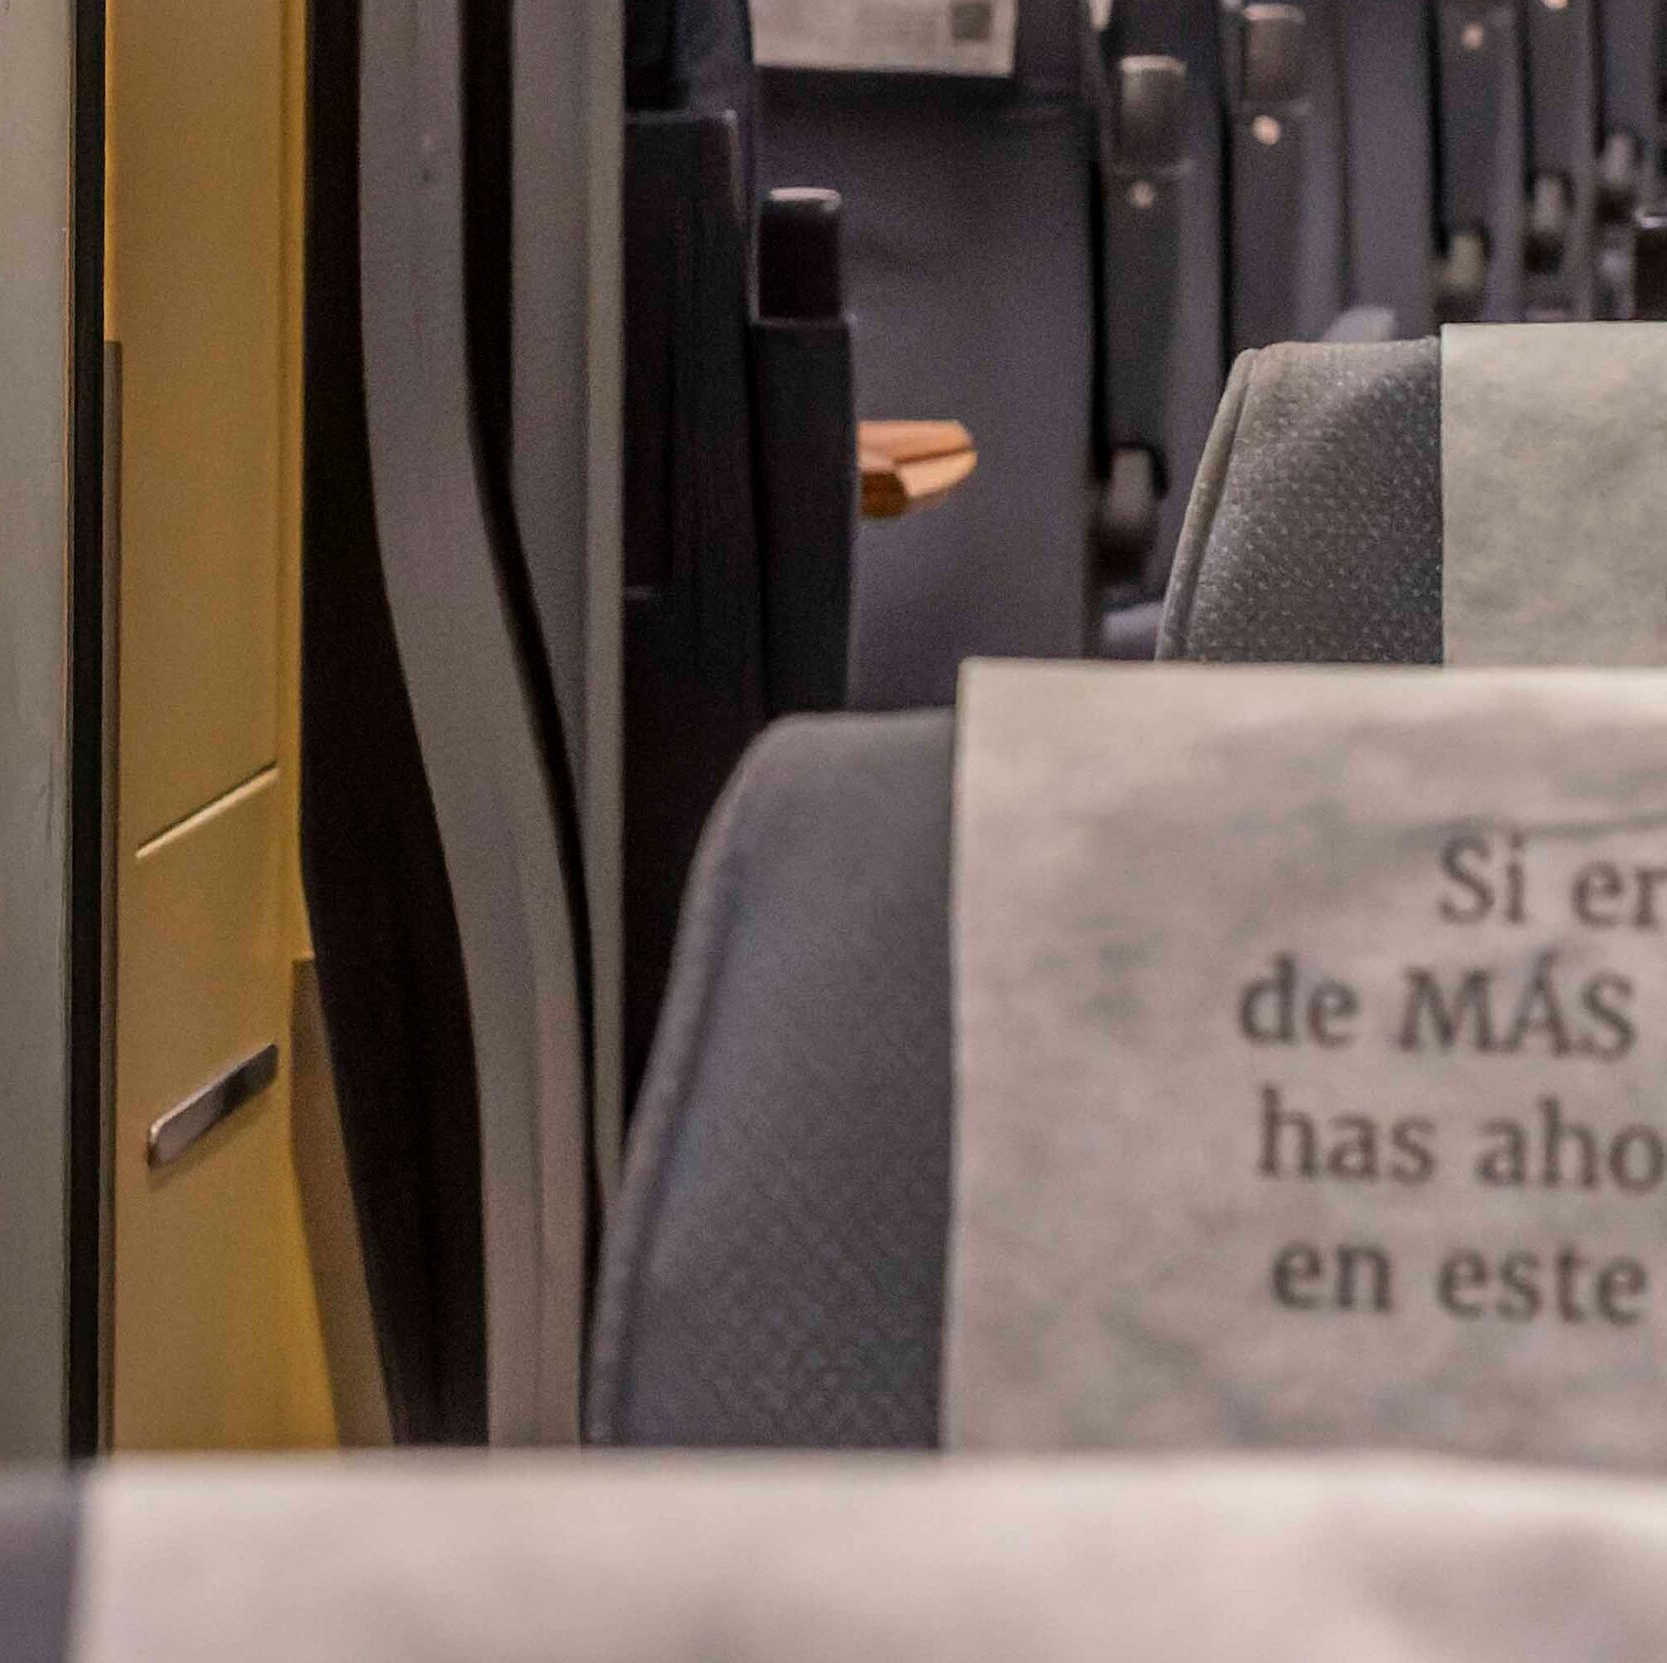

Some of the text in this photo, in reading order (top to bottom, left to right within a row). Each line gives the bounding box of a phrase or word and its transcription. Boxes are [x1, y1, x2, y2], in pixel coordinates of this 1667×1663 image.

[1437, 830, 1525, 924] Si
[1237, 944, 1637, 1062] de MÁS
[1257, 1082, 1667, 1196] has aho
[1270, 1244, 1648, 1330] en este
